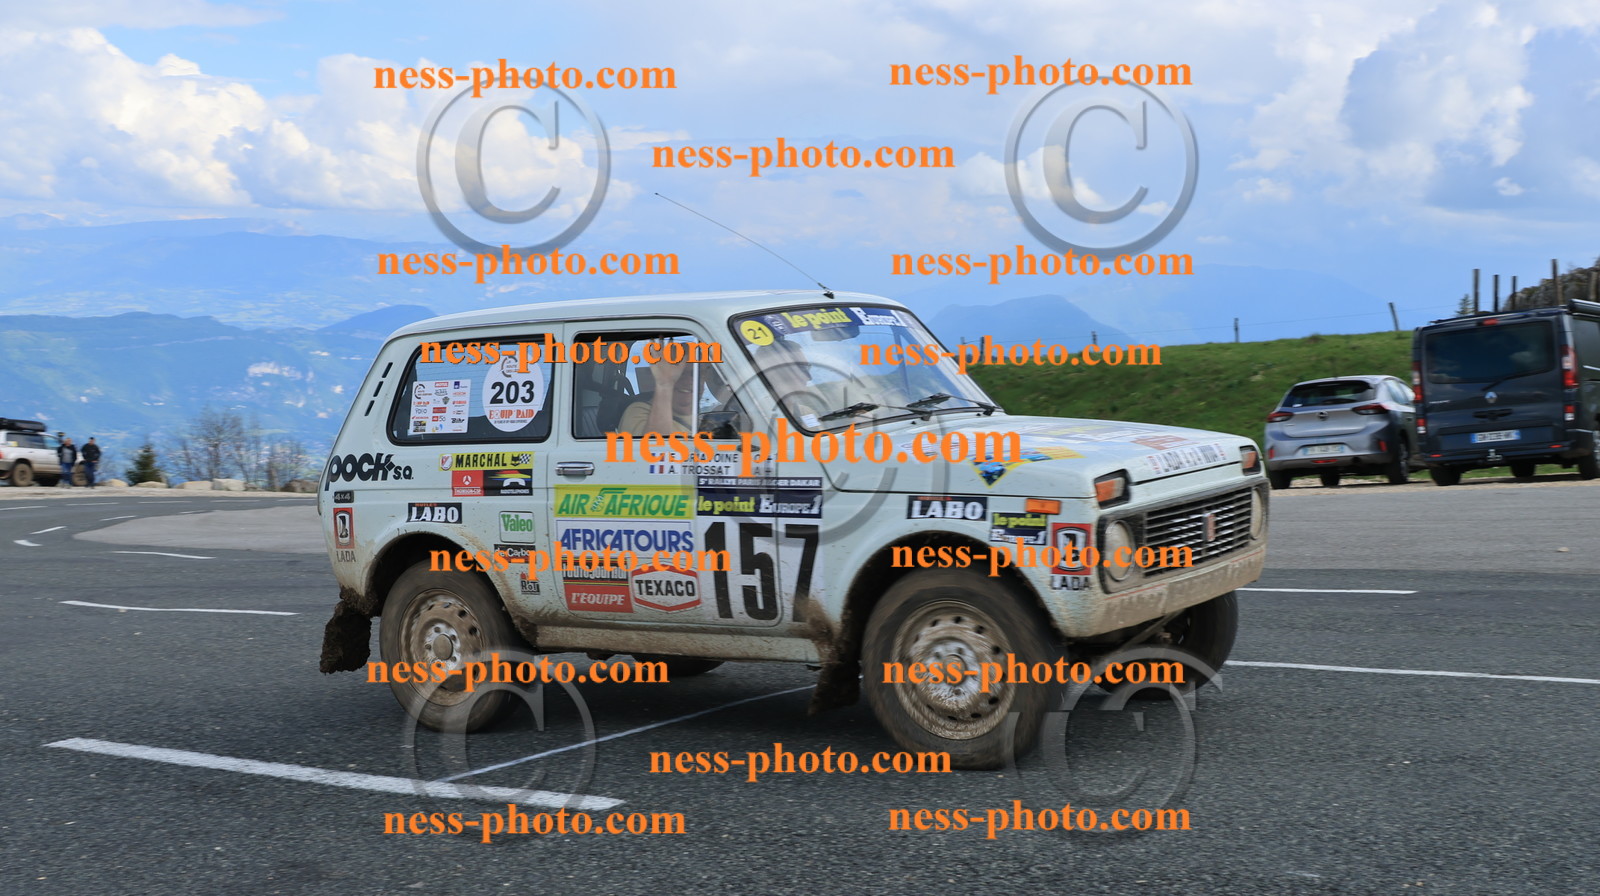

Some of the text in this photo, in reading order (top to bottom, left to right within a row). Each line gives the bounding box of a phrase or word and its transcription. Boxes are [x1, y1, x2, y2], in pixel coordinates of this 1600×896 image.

[803, 308, 852, 329] point
[747, 326, 768, 341] 21
[490, 380, 535, 404] 203
[455, 453, 508, 468] MARCHAL
[685, 452, 738, 463] RIAOINE
[682, 465, 731, 475] TROSSAT
[558, 493, 690, 517] AIR AFRIQUE
[697, 496, 756, 515] le point
[911, 501, 984, 520] LABO
[410, 506, 459, 523] LABO
[501, 514, 534, 532] Valeo
[992, 512, 1047, 528] le point
[560, 528, 694, 553] AFRICATOURS
[336, 551, 356, 562] LADA
[507, 547, 532, 557] Carbo
[704, 522, 820, 622] 157
[635, 580, 695, 597] TEXACO
[1051, 576, 1092, 591] LADA
